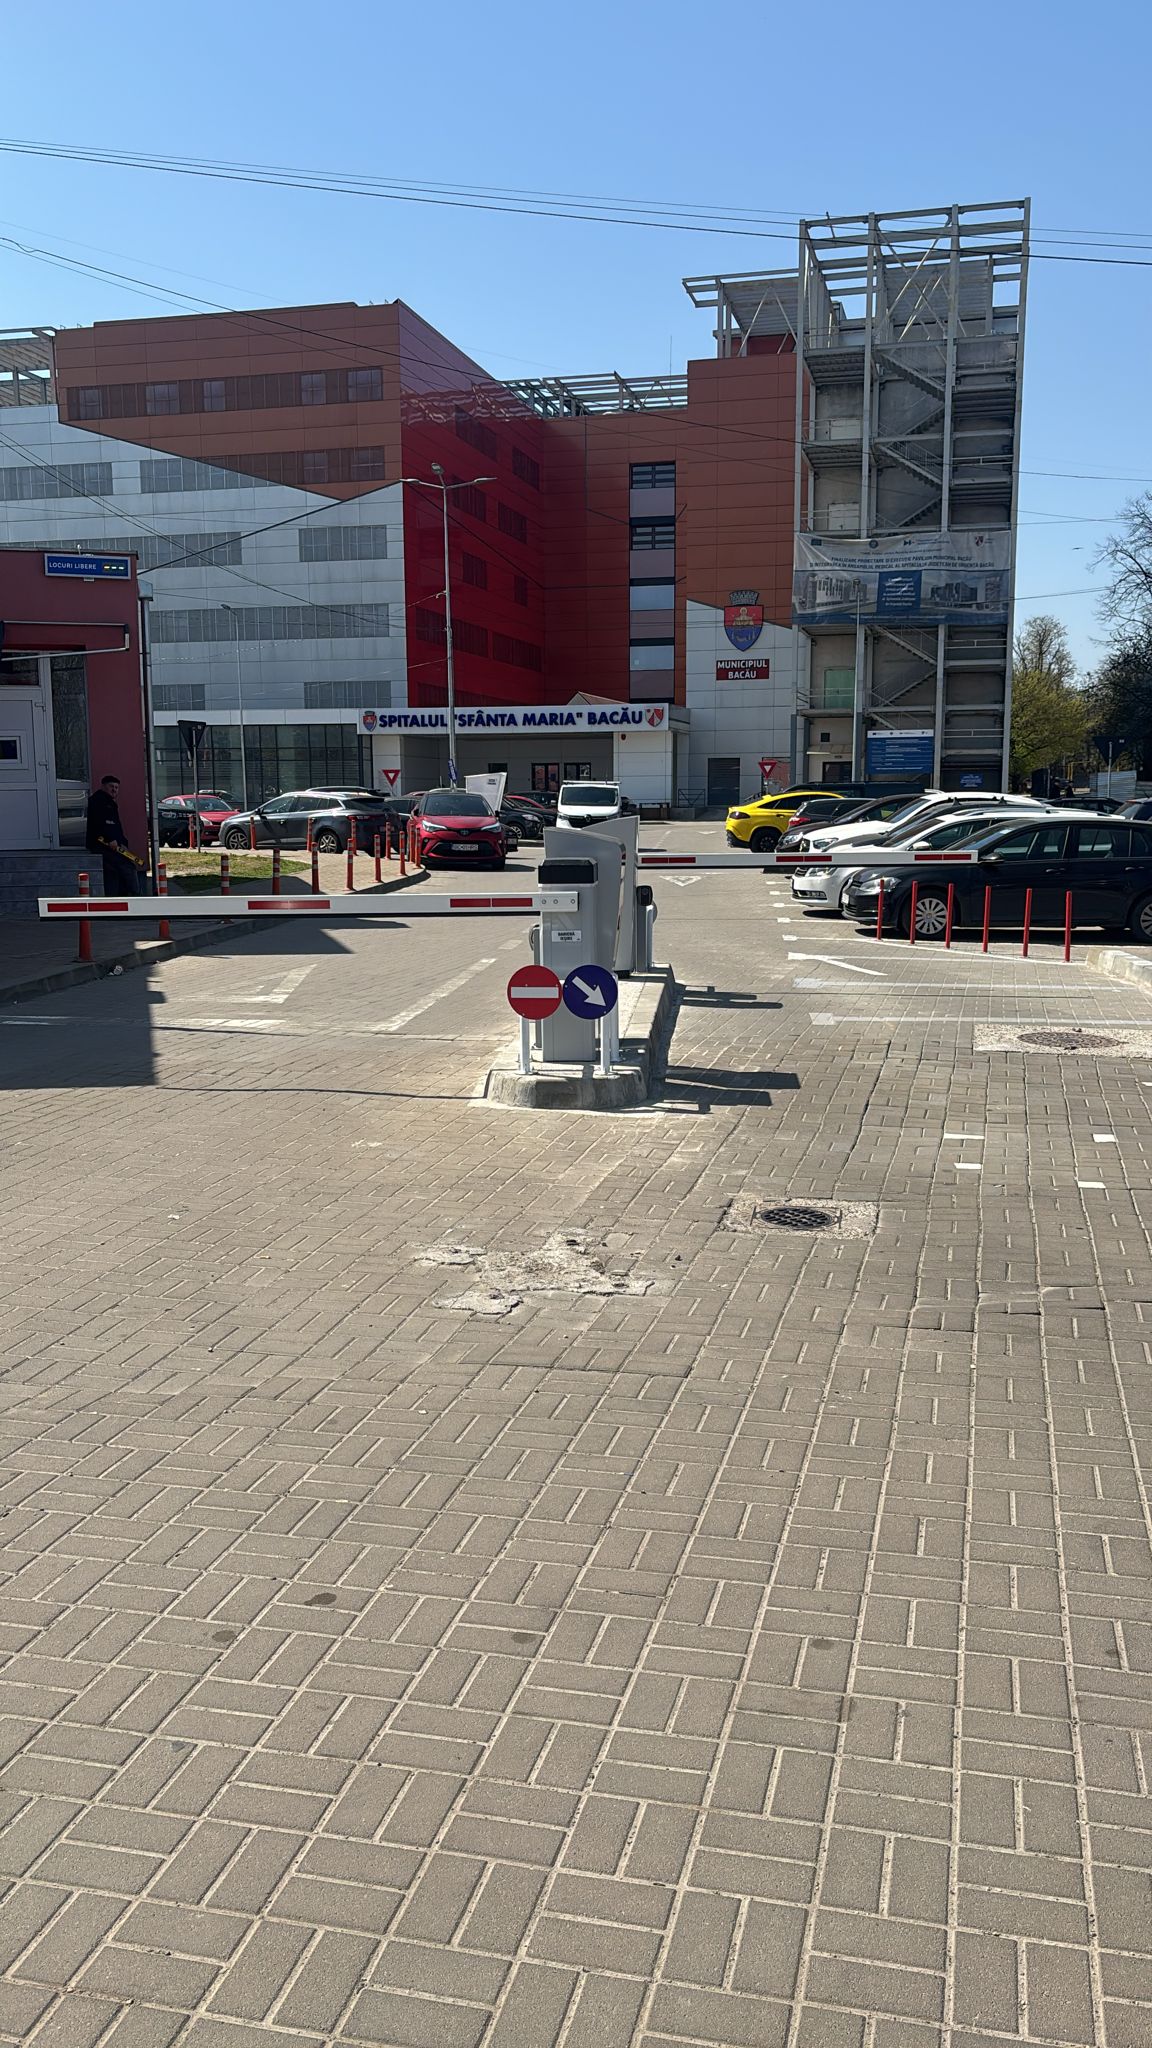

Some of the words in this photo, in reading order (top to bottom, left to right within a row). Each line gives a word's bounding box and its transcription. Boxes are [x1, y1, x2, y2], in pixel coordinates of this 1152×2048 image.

[717, 660, 768, 669] MUNICIPIUL
[728, 669, 757, 679] BACĂU
[379, 714, 448, 728] SPITALUL
[522, 711, 583, 727] MARIA"
[587, 707, 643, 725] BACĂU
